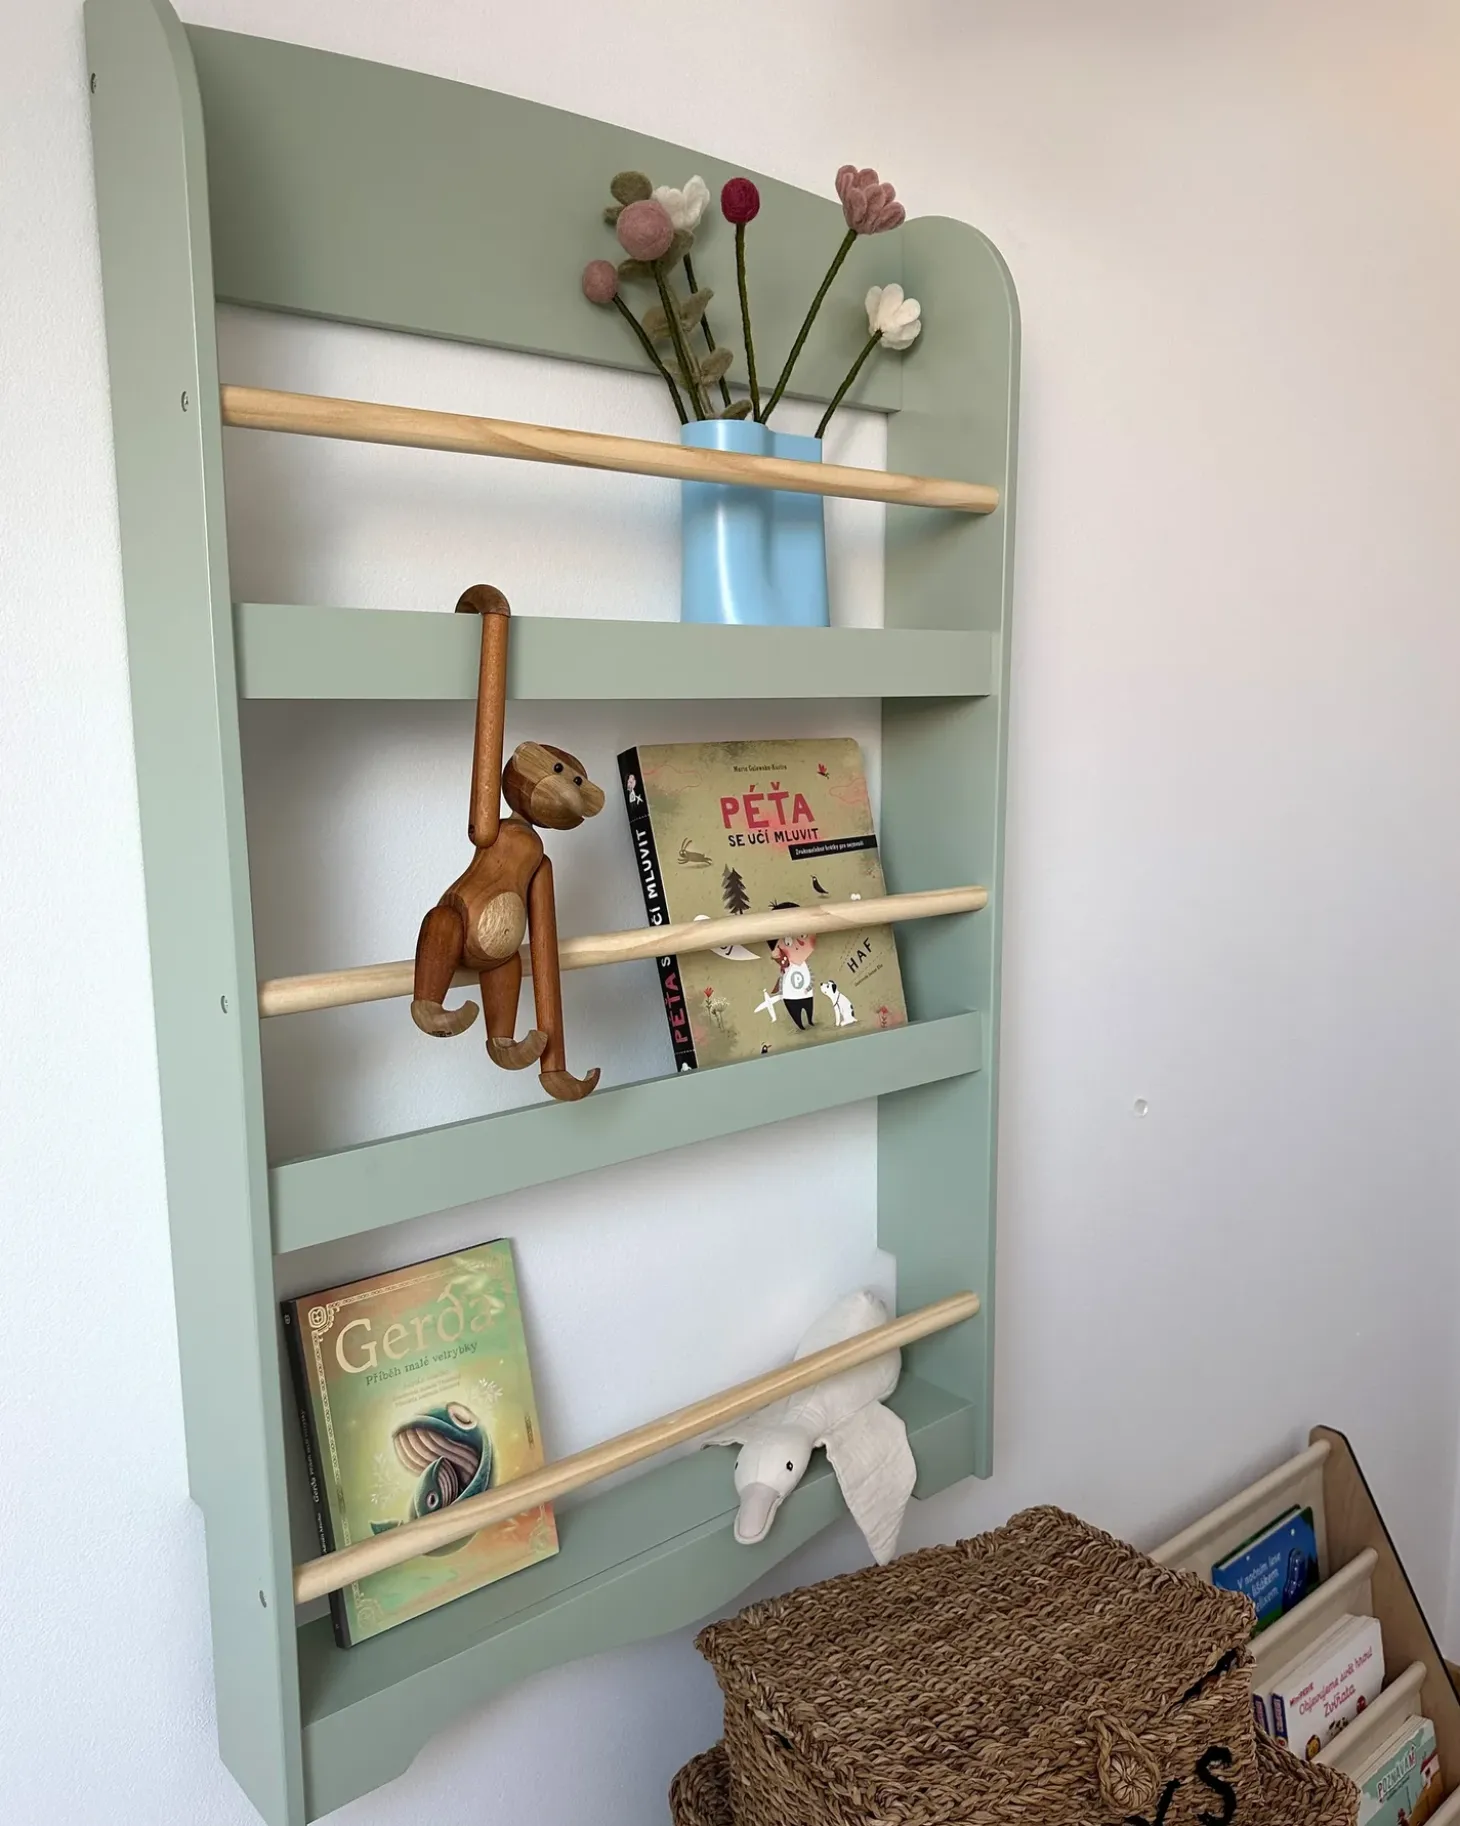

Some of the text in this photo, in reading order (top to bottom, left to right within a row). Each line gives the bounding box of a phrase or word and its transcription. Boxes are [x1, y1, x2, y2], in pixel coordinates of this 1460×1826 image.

[720, 781, 816, 829] PÉŤA
[728, 825, 819, 847] SE UČÍ MLUVIT
[635, 828, 659, 899] MLUVIT
[847, 937, 873, 973] HAF
[664, 971, 689, 1044] PÉŤA
[335, 1283, 499, 1374] Gerda
[365, 1367, 401, 1387] Příběh
[404, 1358, 429, 1373] malé
[432, 1341, 478, 1363] velrybky
[1298, 1676, 1340, 1716] Objevujeme
[1323, 1683, 1356, 1718] Zvířata
